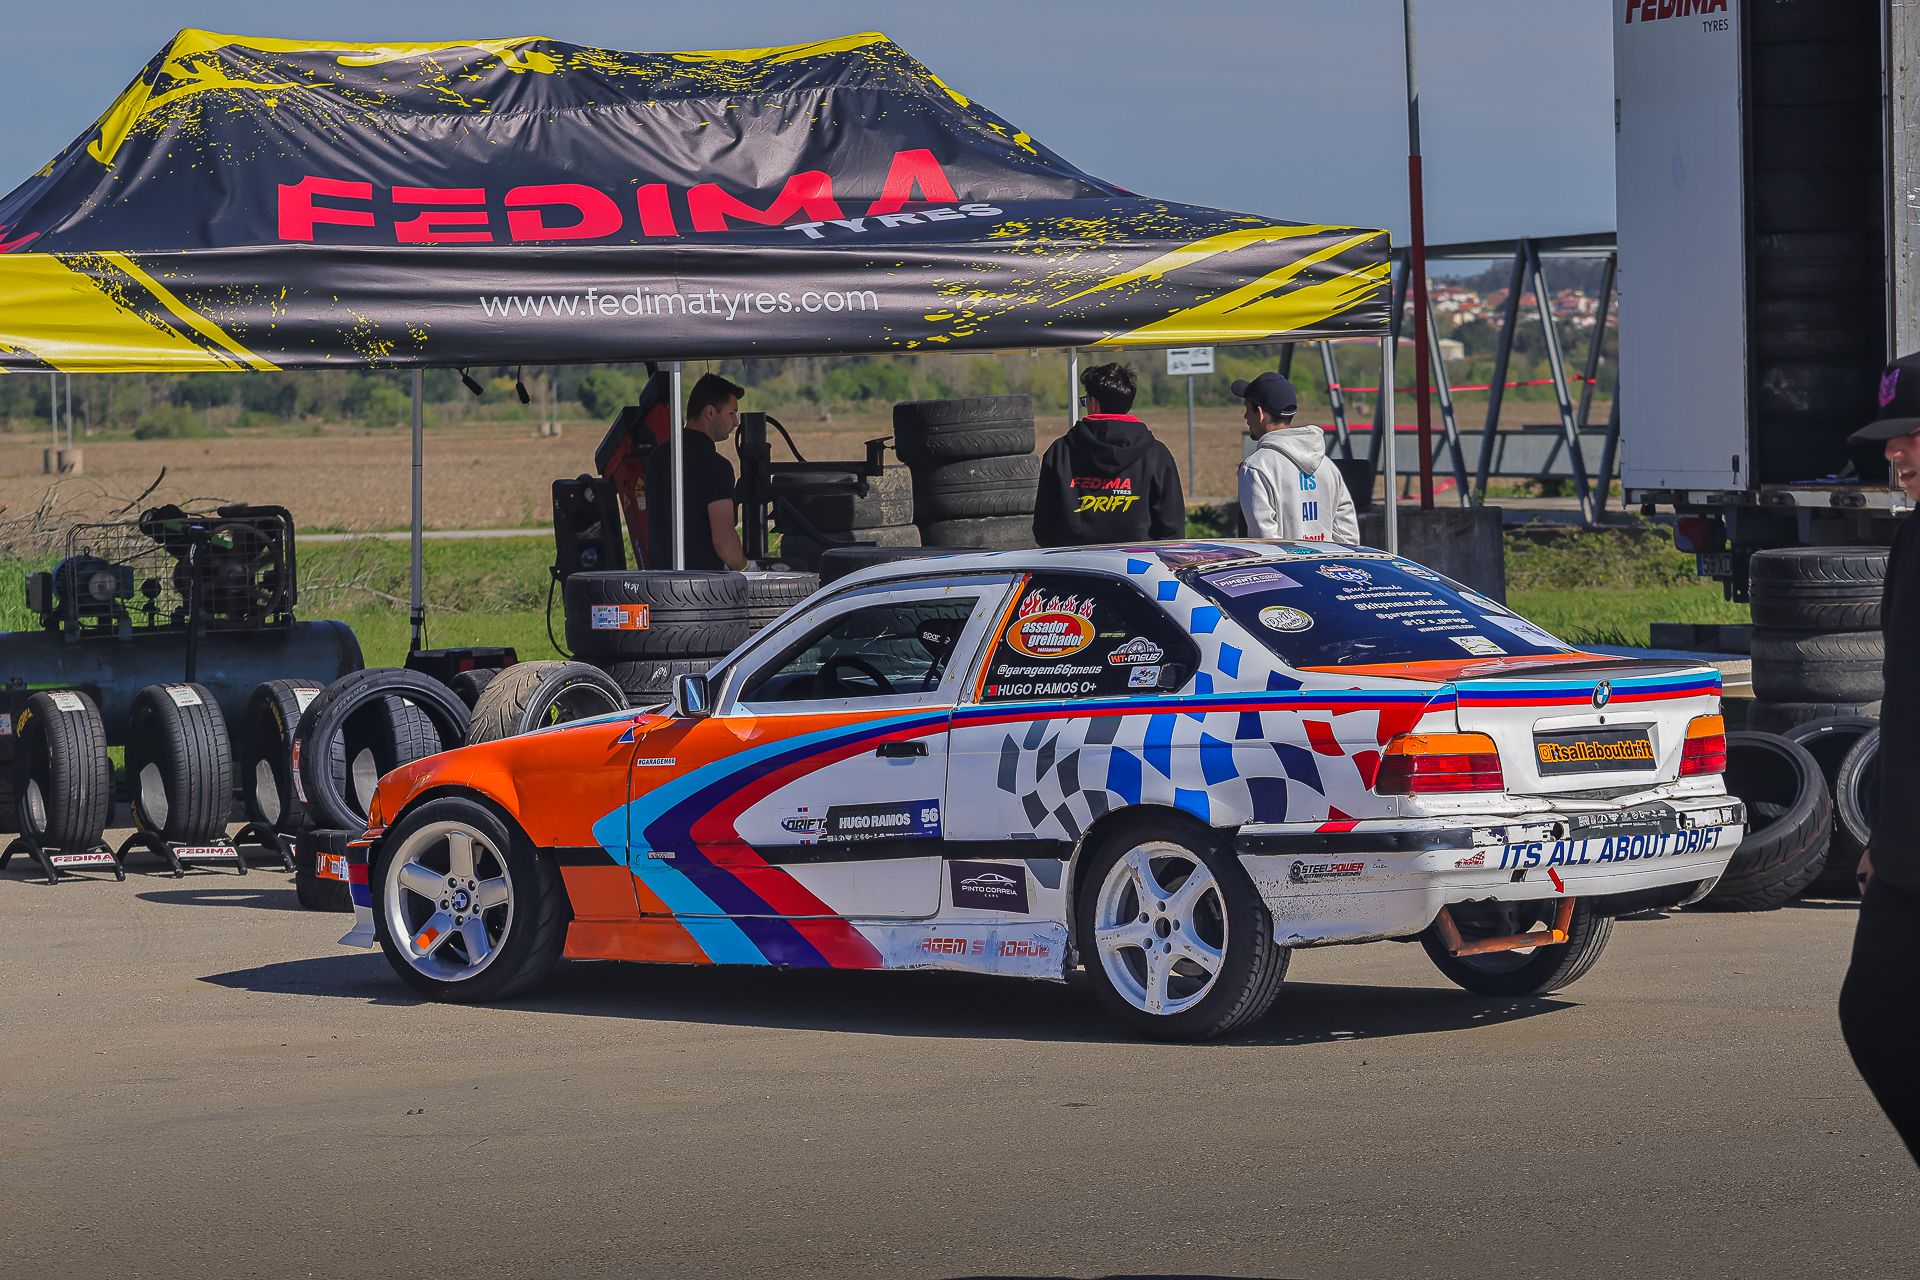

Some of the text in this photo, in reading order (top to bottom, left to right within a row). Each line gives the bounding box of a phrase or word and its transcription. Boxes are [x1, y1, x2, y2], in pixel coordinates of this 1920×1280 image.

[1702, 18, 1729, 33] TYRES
[278, 149, 960, 243] FEDIMA
[784, 203, 1004, 240] TYRES
[480, 287, 879, 321] www.fedimatyres.com
[1069, 477, 1132, 490] FEDIMA
[1073, 495, 1141, 513] DRIFT
[1219, 576, 1259, 587] PIMENTA
[1021, 620, 1070, 634] assador
[1027, 633, 1085, 648] grelhador
[997, 664, 1103, 678] @garagem66pneus
[997, 681, 1097, 696] HUGO RAMOS O+
[839, 813, 911, 829] HUGO RAMOS
[920, 808, 939, 823] 56
[785, 818, 826, 831] DRIFT
[176, 847, 235, 856] FEDIMA
[1498, 827, 1723, 870] ITS ALL ABOUT DRIFT
[53, 852, 113, 863] FEDIMA
[961, 885, 1018, 896] PINTO CORREIA
